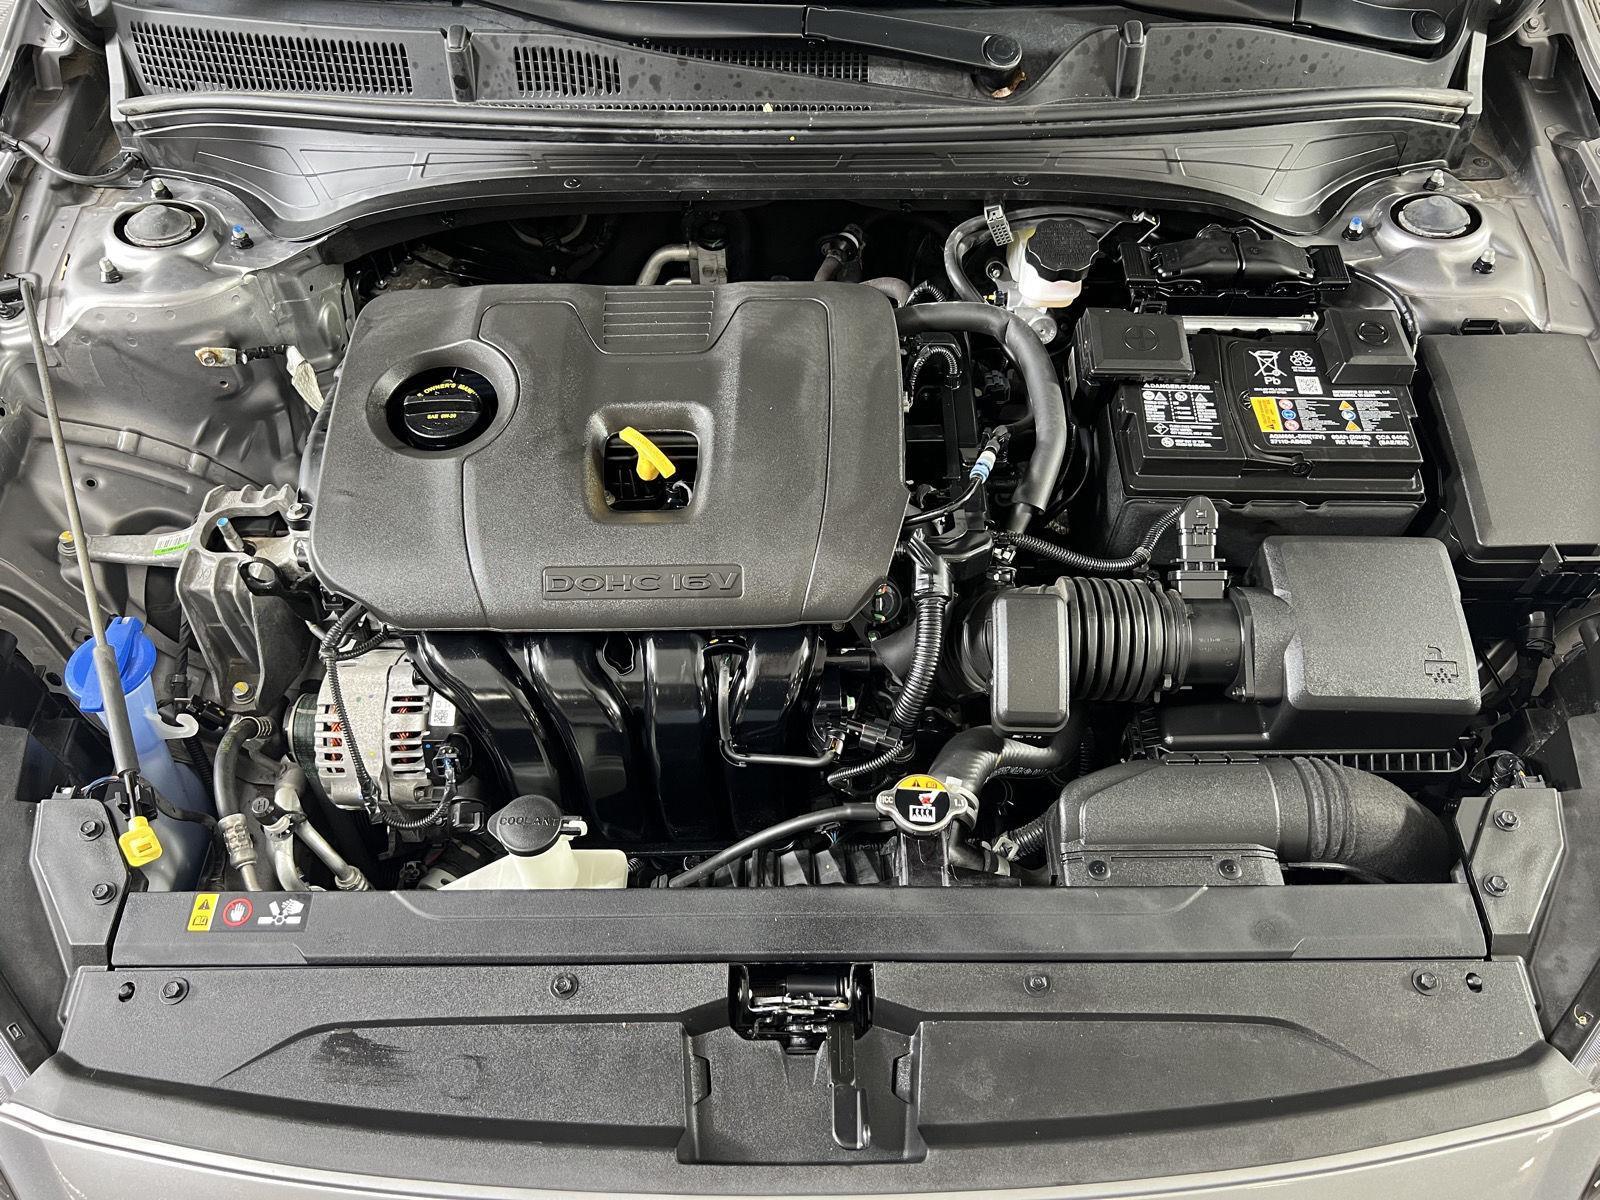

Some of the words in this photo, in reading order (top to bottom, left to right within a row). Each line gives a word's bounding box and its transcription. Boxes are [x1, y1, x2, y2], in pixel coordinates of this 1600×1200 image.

[1264, 376, 1281, 385] Pb
[424, 383, 457, 394] OWNER'S
[546, 573, 661, 593] DOHC
[671, 571, 741, 591] 16V
[500, 816, 559, 827] COOLANT
